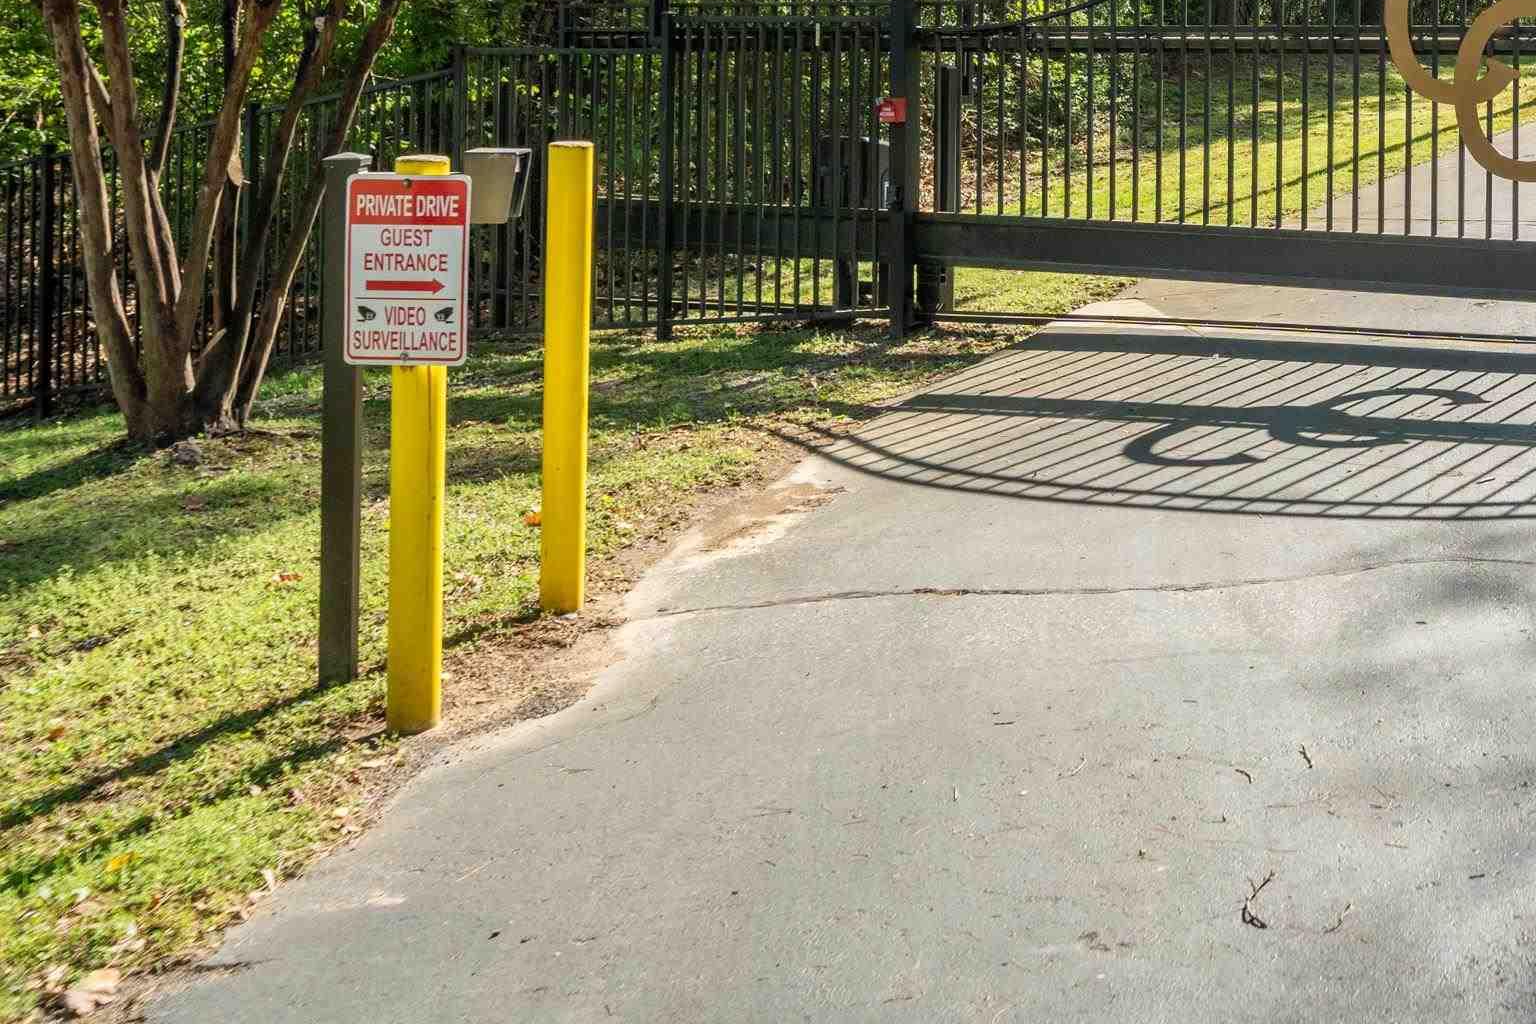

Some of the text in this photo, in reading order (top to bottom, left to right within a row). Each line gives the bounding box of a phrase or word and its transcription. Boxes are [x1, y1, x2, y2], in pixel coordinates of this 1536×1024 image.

[356, 194, 460, 217] PRIVATE DRIVE
[380, 228, 433, 247] GUEST
[363, 253, 449, 272] ENTRANCE
[384, 306, 426, 326] VIDEO
[353, 330, 457, 352] SURVEILLANCE
